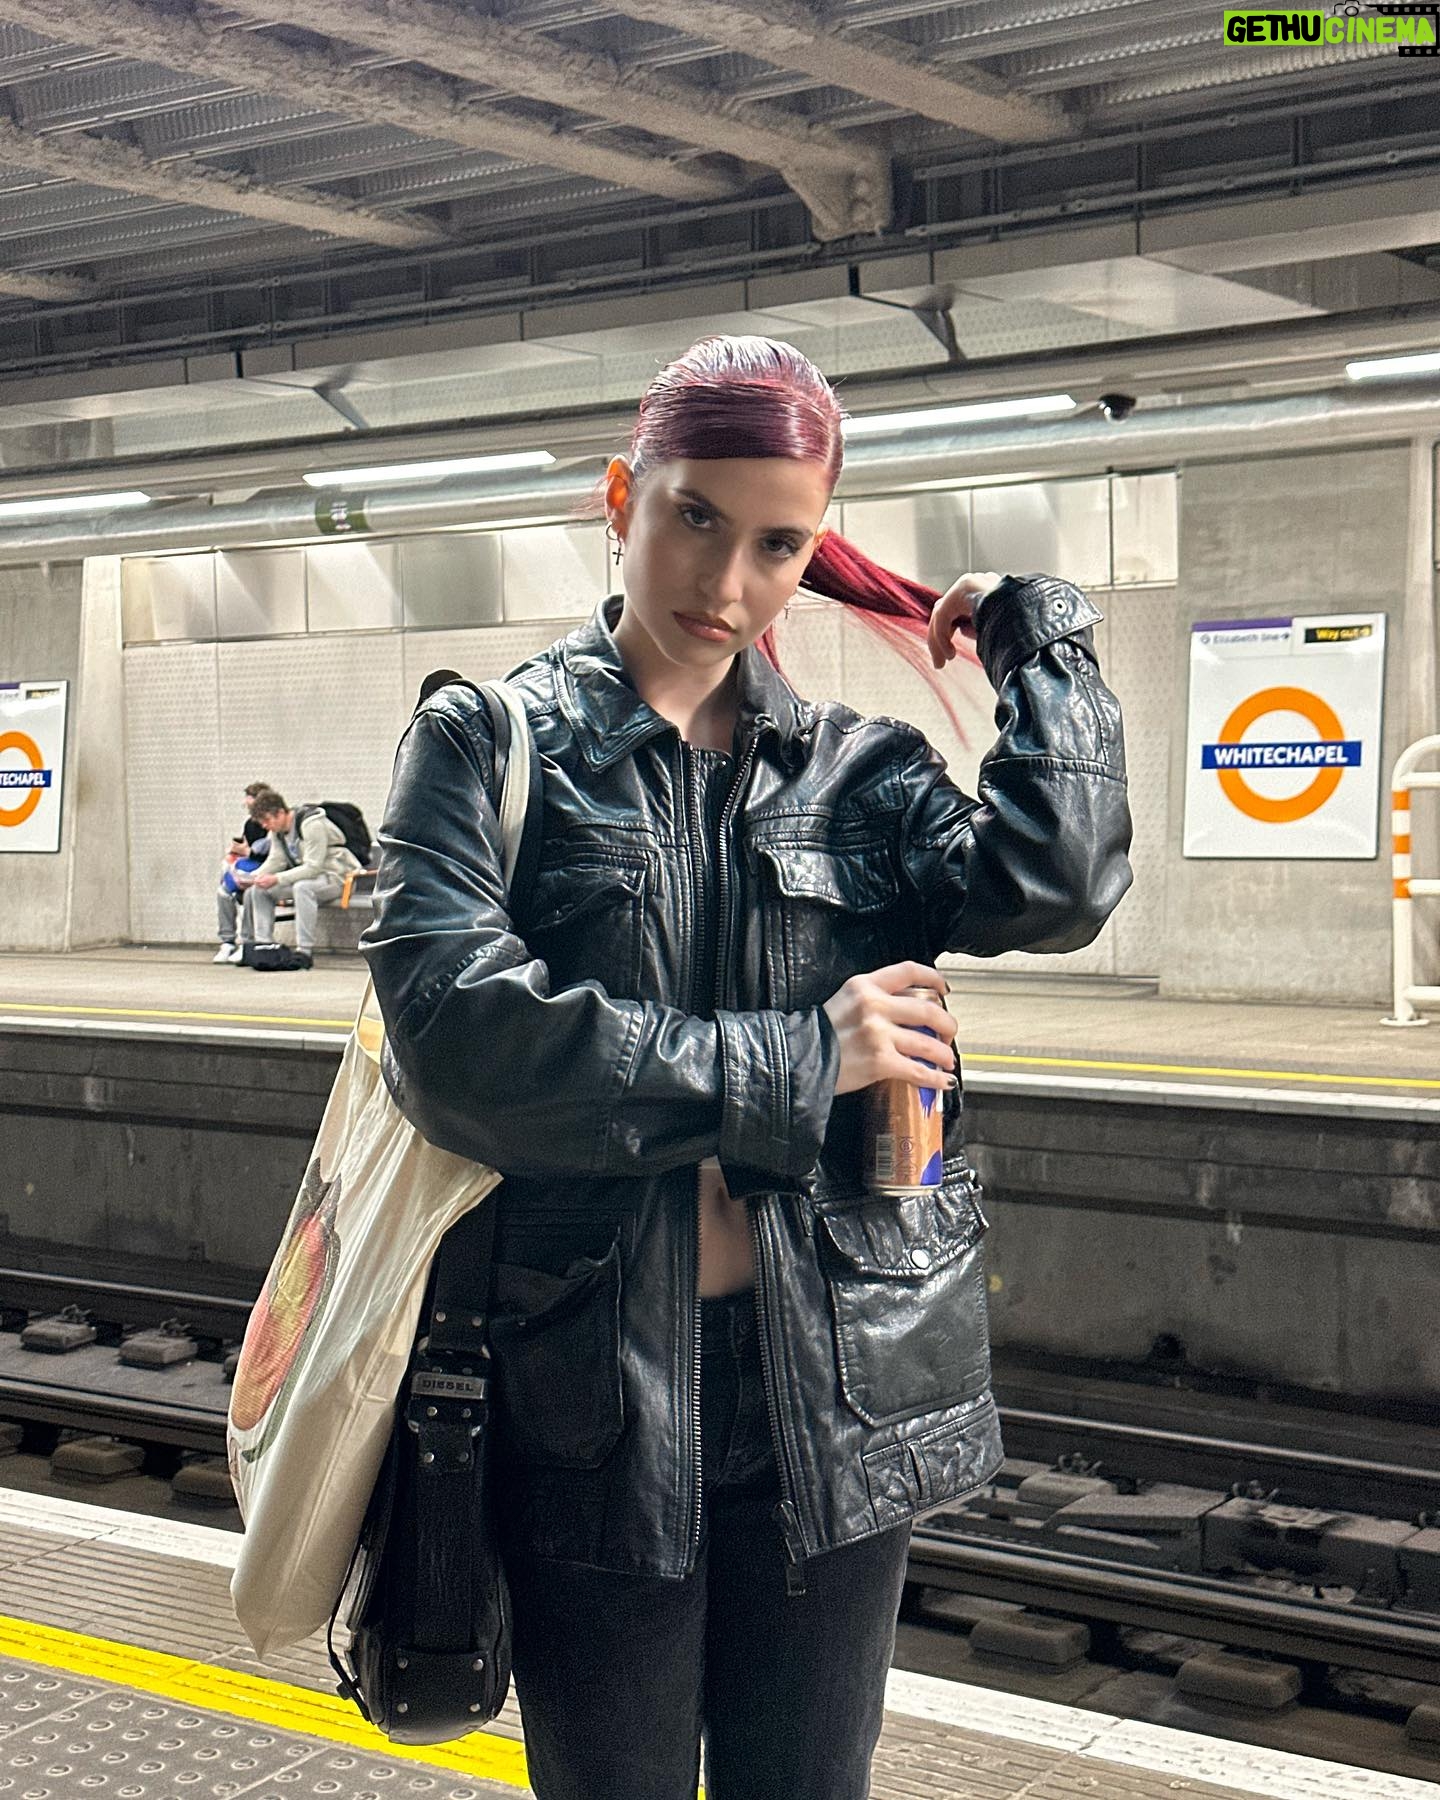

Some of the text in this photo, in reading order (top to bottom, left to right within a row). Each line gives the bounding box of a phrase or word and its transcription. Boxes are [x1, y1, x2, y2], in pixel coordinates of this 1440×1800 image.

[1316, 627, 1338, 640] Way
[1214, 745, 1348, 765] WHITECHAPEL
[422, 1380, 474, 1392] DIESEL
